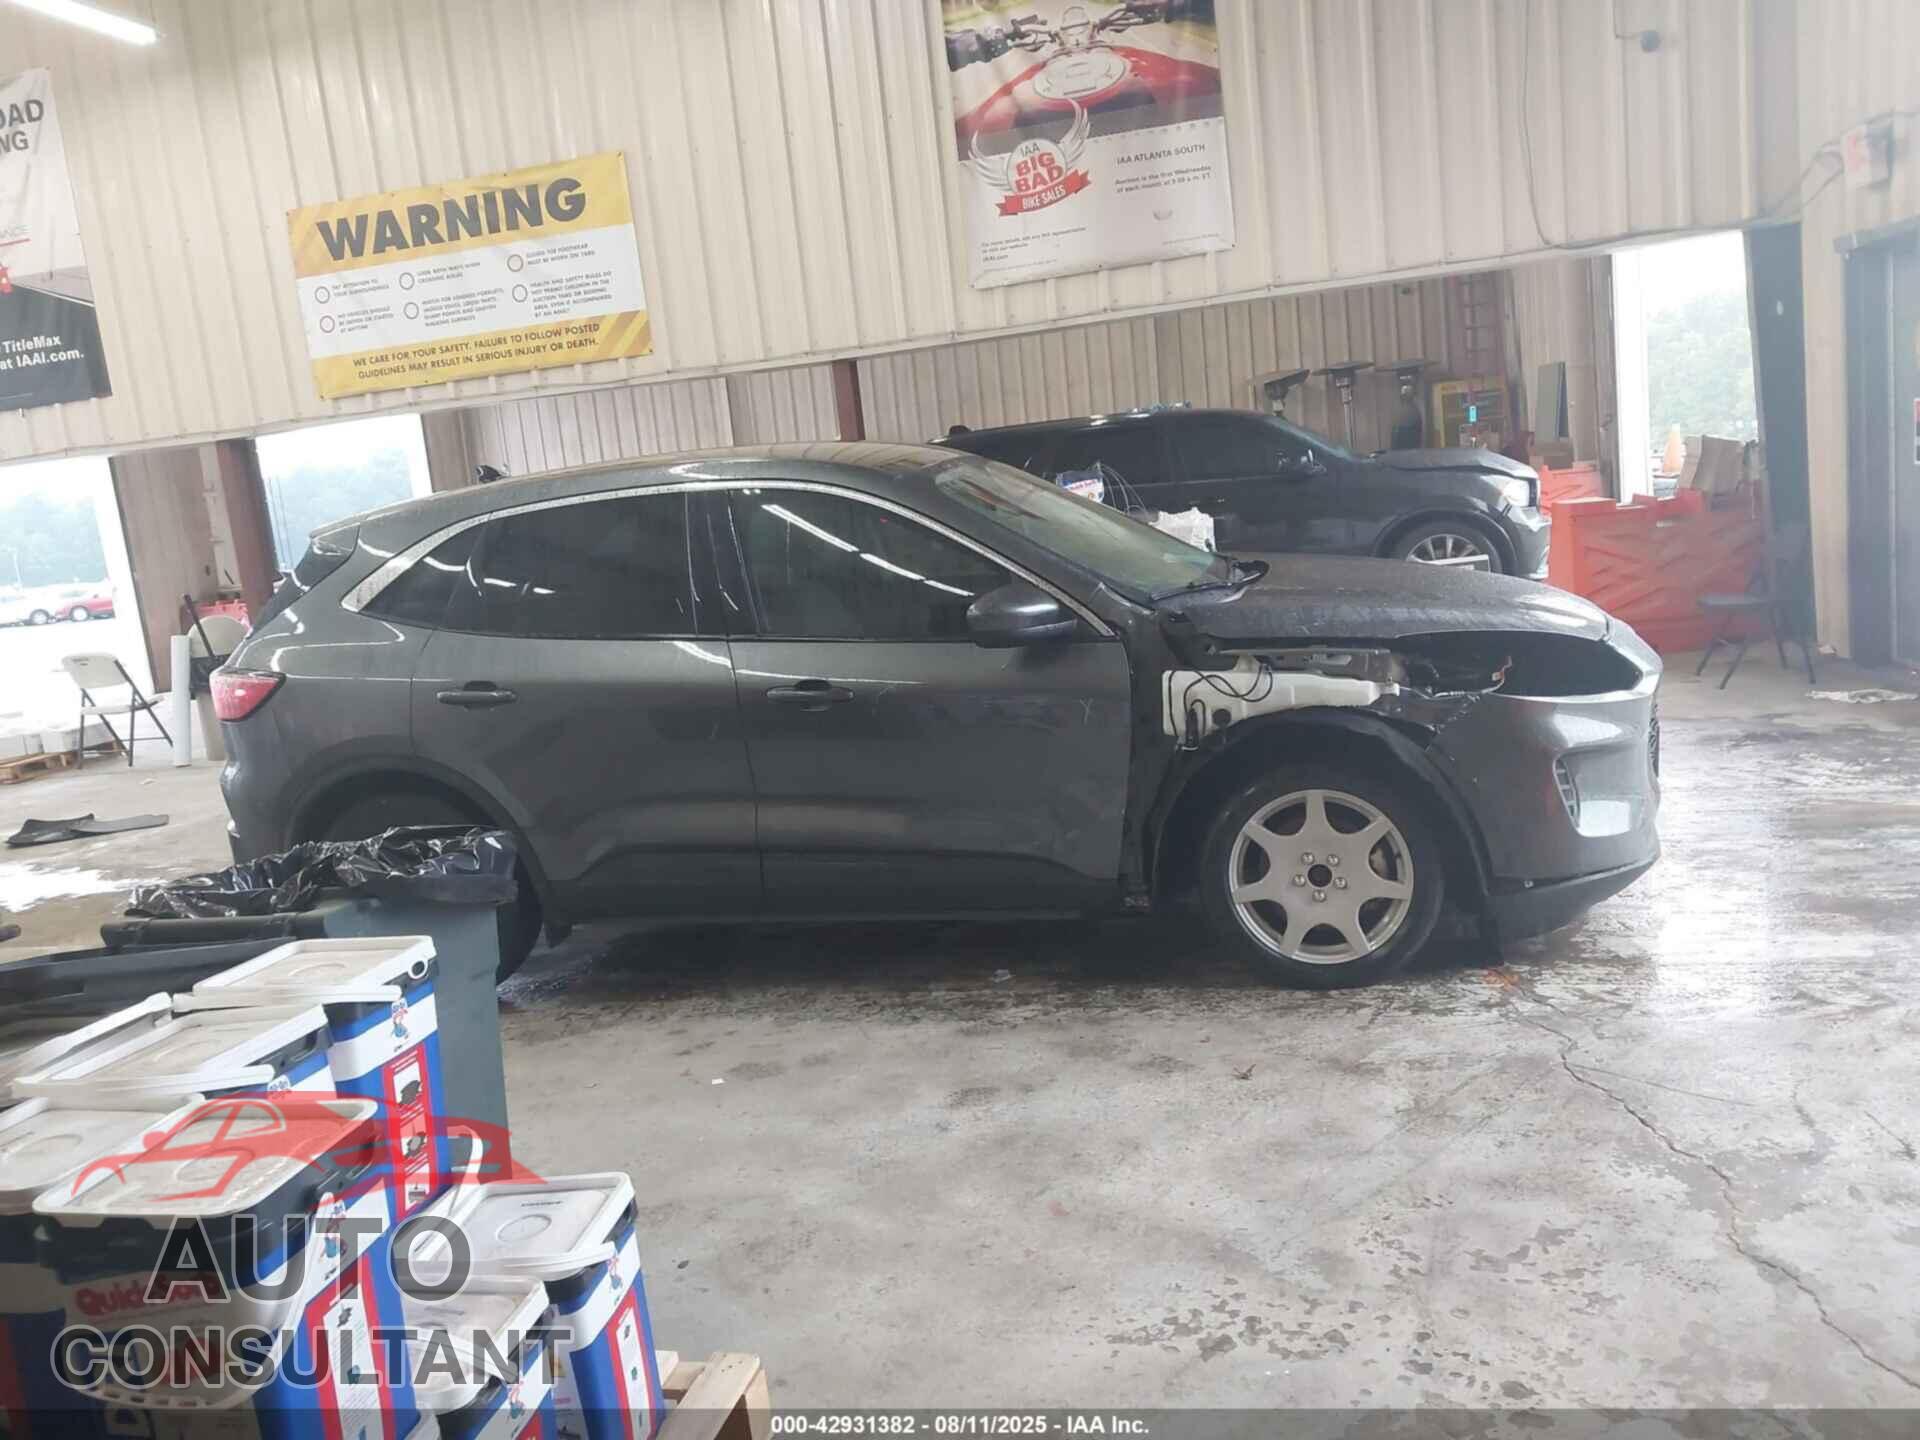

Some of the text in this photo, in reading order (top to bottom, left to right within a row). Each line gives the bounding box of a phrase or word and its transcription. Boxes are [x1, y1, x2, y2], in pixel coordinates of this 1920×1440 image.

[1020, 142, 1041, 157] IAA
[1117, 144, 1205, 165] IAA ATLANTA SOUTH
[1016, 152, 1056, 177] BIG
[1015, 165, 1064, 192] BAD
[1041, 185, 1066, 204] SALES
[316, 177, 586, 261] WARNING
[2, 336, 61, 353] TitleMax
[352, 359, 367, 367] WE
[369, 354, 389, 364] CARE
[392, 351, 409, 361] FOR
[413, 347, 436, 358] YOUR
[474, 337, 508, 348] FAILURE
[510, 334, 522, 343] TO
[524, 328, 562, 340] FOLLOW
[565, 323, 600, 335] POSTED
[0, 349, 84, 370] at IAAI.com.
[358, 338, 599, 379] GUIDELINES MAY RESULT IN SERIOUS INJURY OR DEATH.
